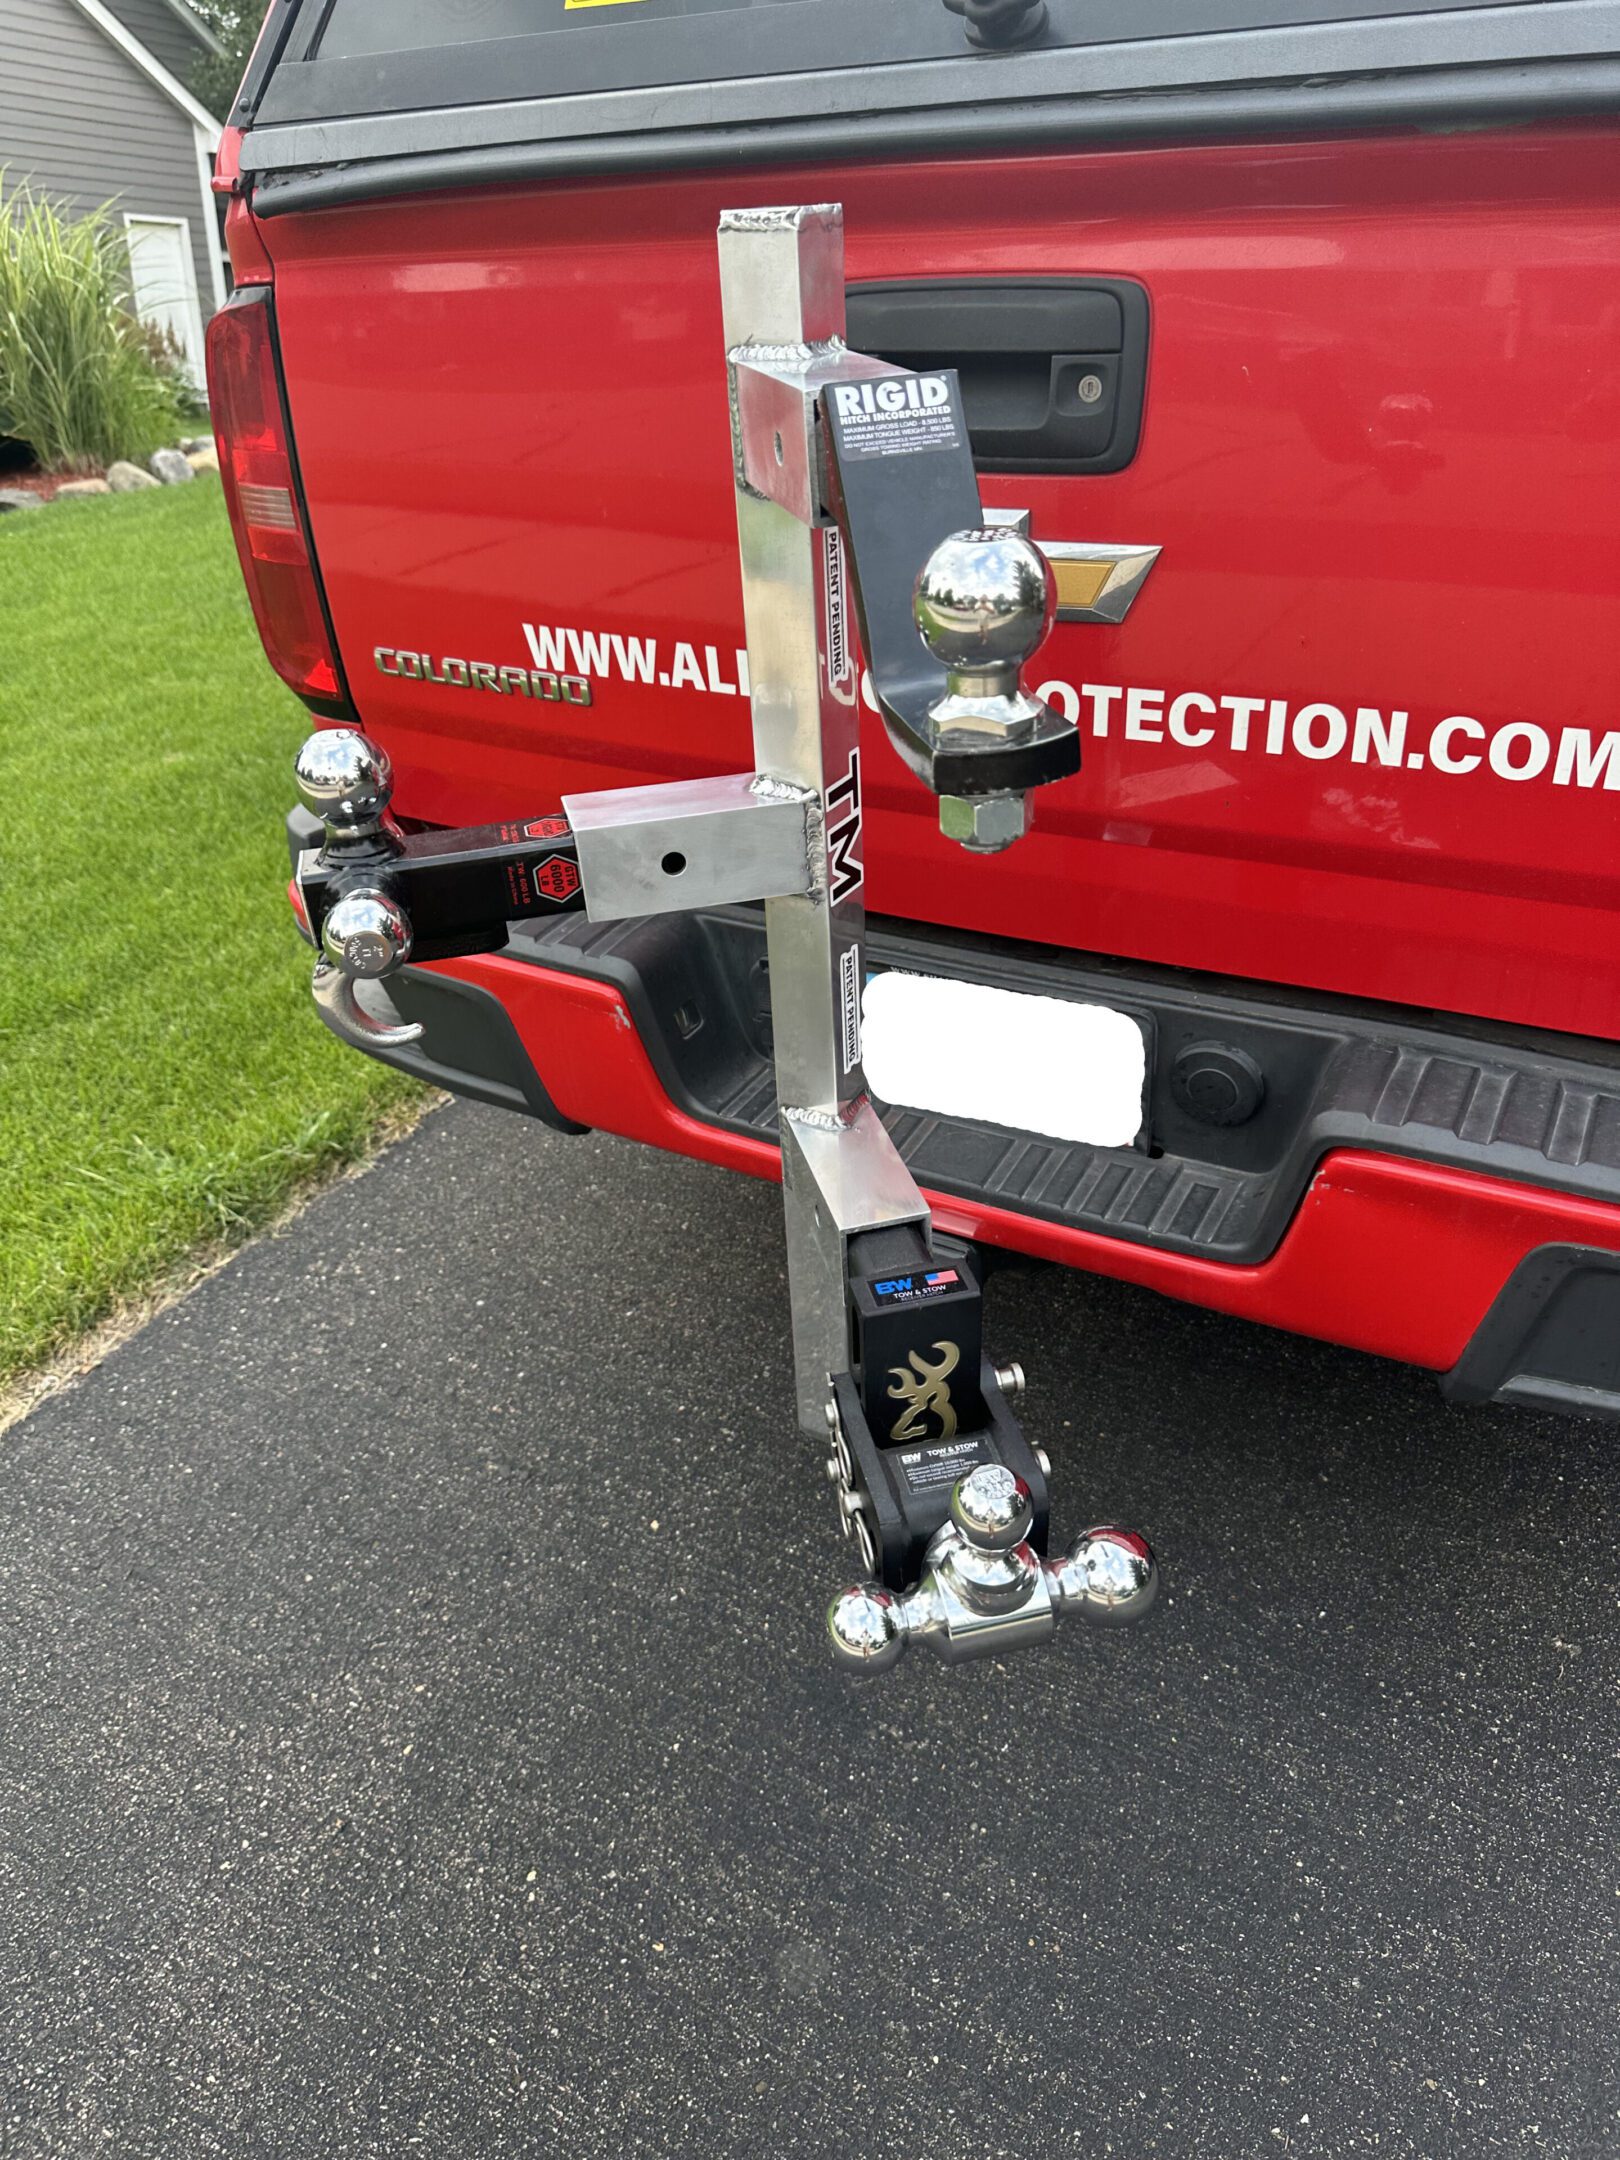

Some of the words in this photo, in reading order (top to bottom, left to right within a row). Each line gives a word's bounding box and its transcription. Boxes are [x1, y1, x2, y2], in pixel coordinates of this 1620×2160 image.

[834, 377, 949, 416] RIGID
[840, 414, 870, 425] HITCH
[873, 405, 951, 421] INCORPORATED
[843, 425, 875, 434] MAXIMUM
[875, 422, 899, 431] GROSS
[899, 420, 917, 428] LOAD
[843, 433, 874, 442] MAXIMUM
[875, 429, 900, 438] TONGUE
[901, 426, 926, 435] WEIGHT
[941, 422, 955, 431] LBS
[829, 531, 839, 596] PATENT
[831, 601, 842, 676] PENDING
[374, 646, 592, 706] COLORADO
[827, 750, 862, 904] TM
[550, 864, 565, 893] 6000
[565, 865, 576, 886] GTW
[845, 957, 853, 1004] PATENT
[847, 1006, 856, 1062] PENDING
[893, 1290, 913, 1299] TOW
[922, 1284, 947, 1294] STOW
[926, 1446, 946, 1457] TOW
[954, 1441, 978, 1452] STOW
